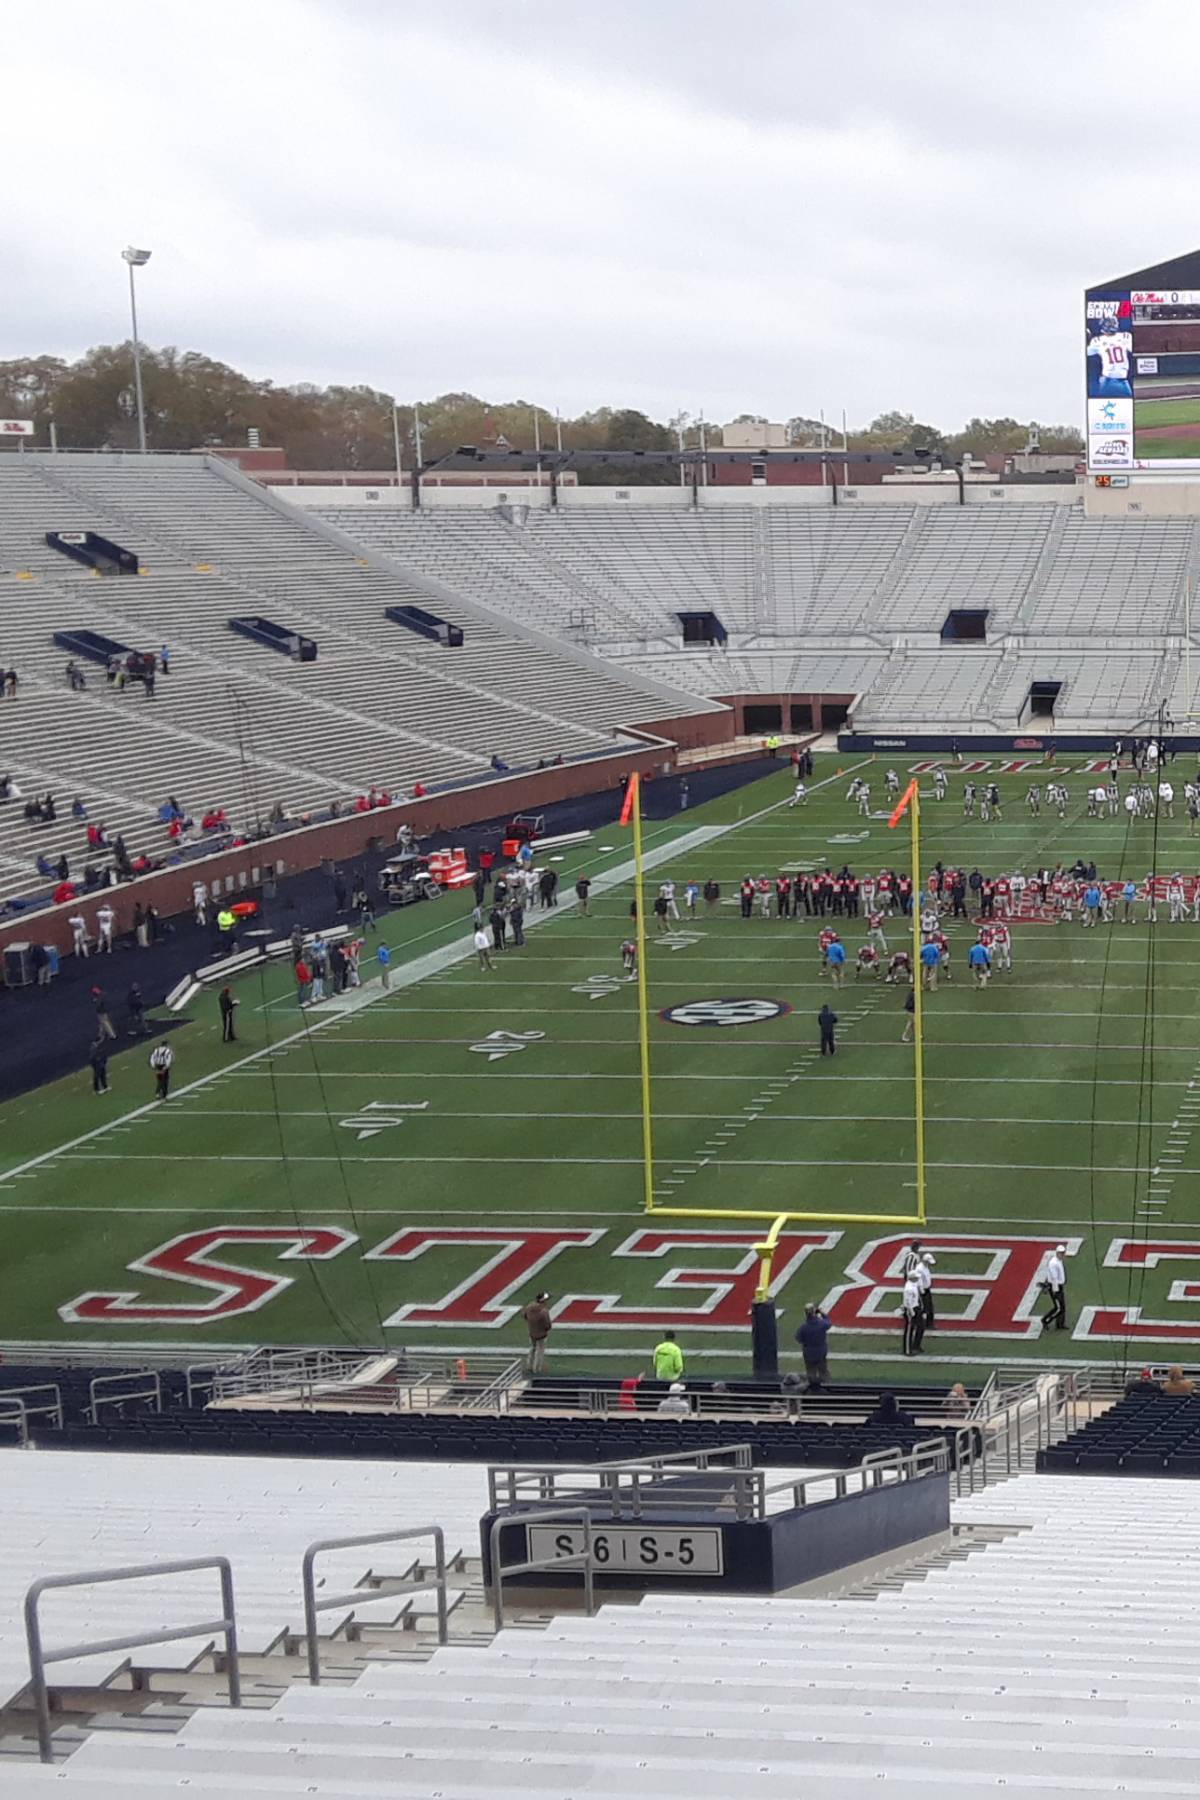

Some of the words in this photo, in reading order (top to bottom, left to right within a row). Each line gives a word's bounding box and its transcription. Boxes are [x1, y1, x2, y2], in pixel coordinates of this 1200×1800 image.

[1171, 292, 1179, 303] 0
[1106, 346, 1124, 364] 10
[873, 739, 907, 747] NISSAN
[468, 1030, 546, 1054] 20
[338, 1100, 430, 1129] 10
[639, 1536, 695, 1565] S-5
